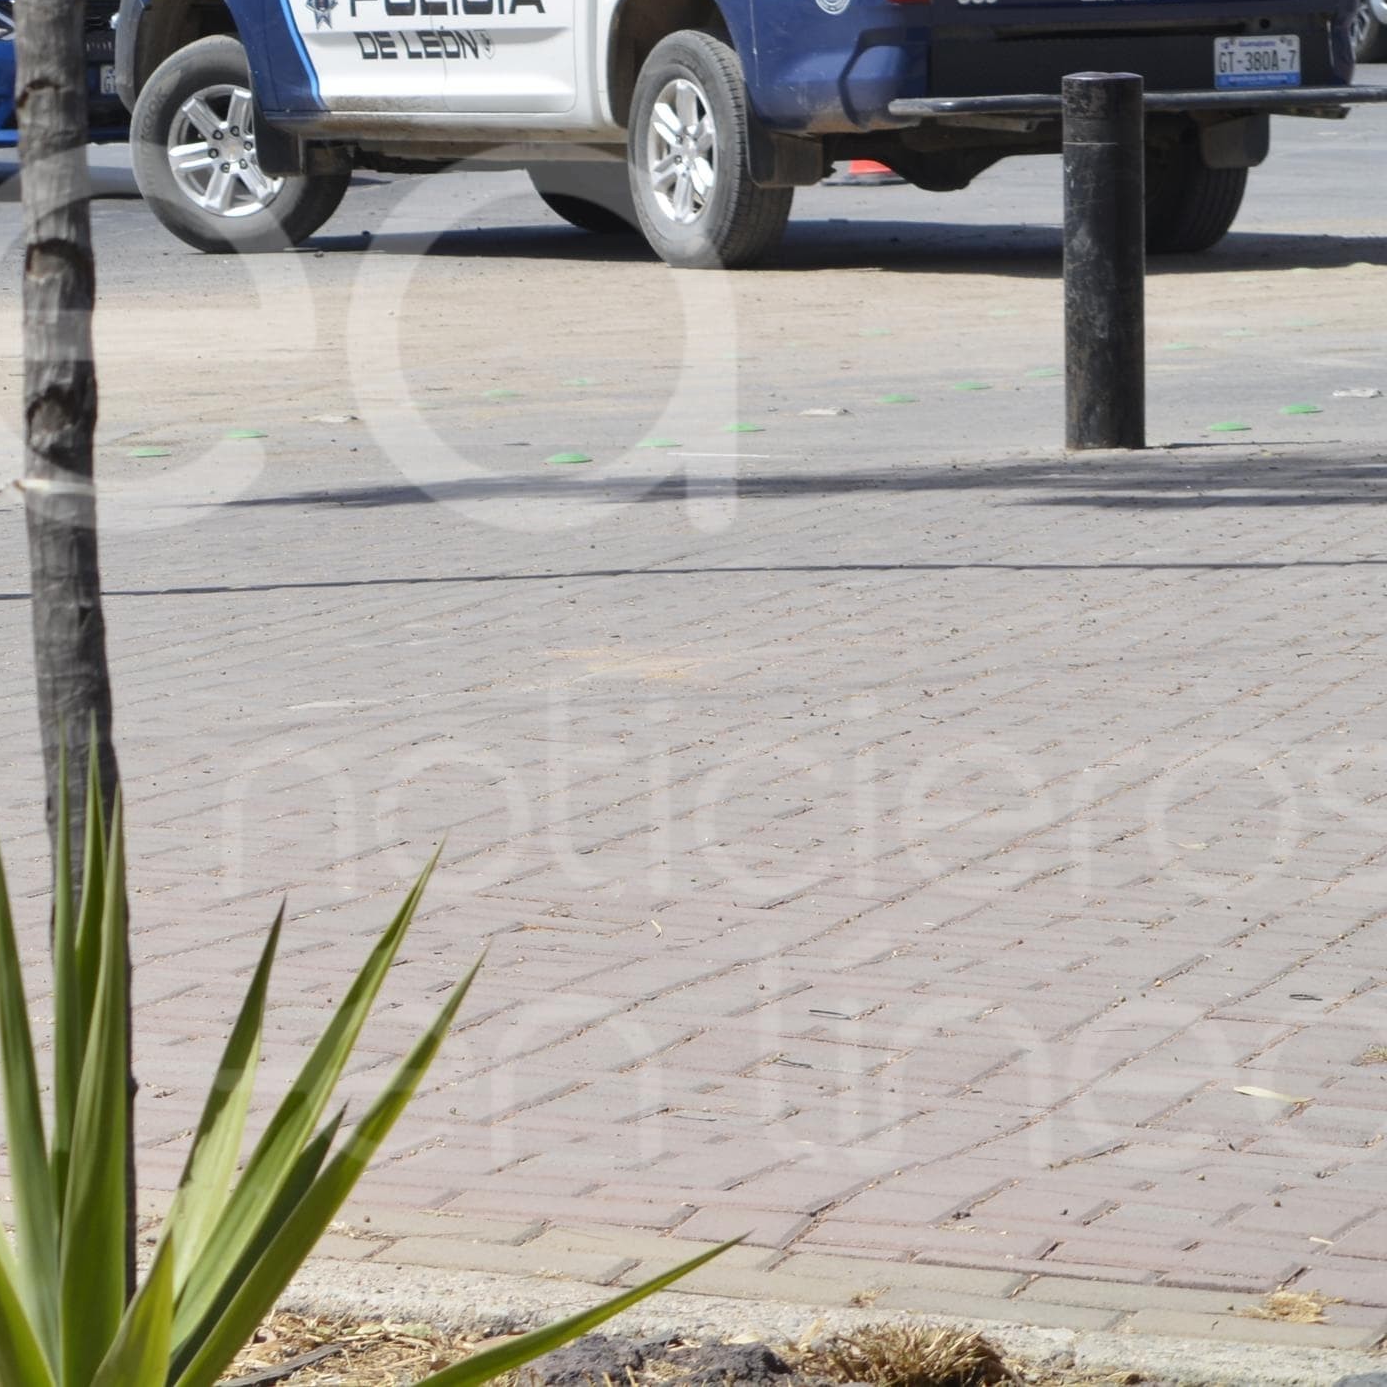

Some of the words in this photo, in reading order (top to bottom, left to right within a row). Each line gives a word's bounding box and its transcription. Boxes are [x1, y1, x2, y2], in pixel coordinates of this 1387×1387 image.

[353, 30, 399, 60] DE
[399, 25, 480, 60] LEÓN
[1218, 49, 1297, 73] GT-380A-7
